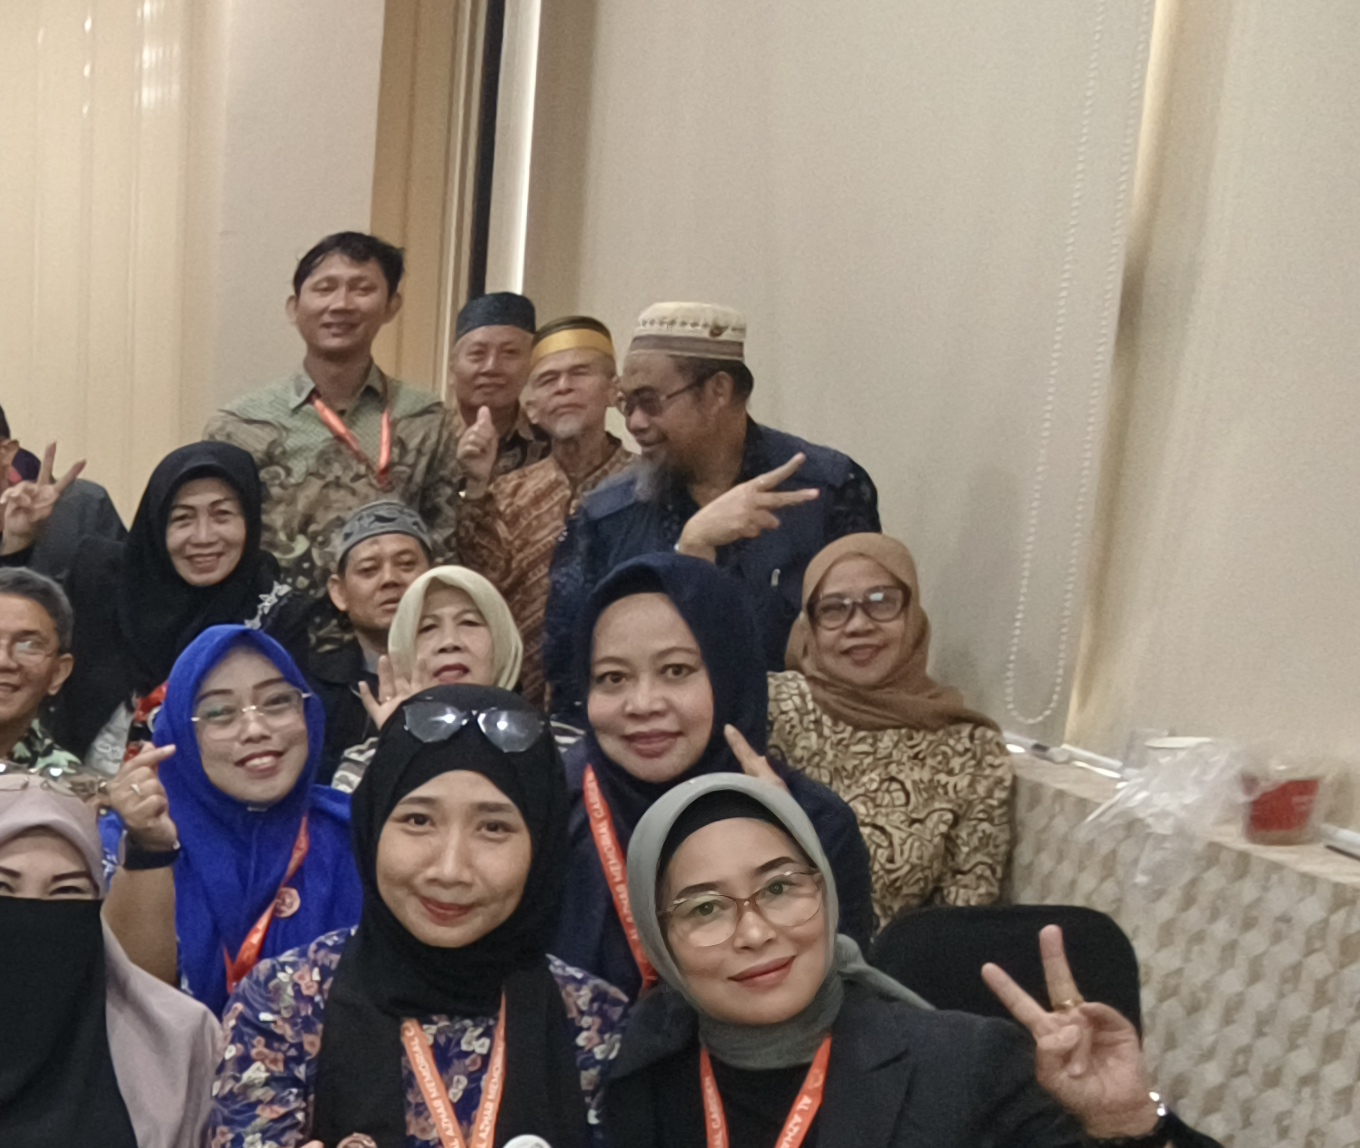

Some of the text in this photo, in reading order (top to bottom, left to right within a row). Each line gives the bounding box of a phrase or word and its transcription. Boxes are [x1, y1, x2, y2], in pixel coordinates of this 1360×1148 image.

[431, 1099, 456, 1138] AZHAR
[478, 1101, 496, 1141] AZHAR
[796, 1094, 813, 1111] AL
